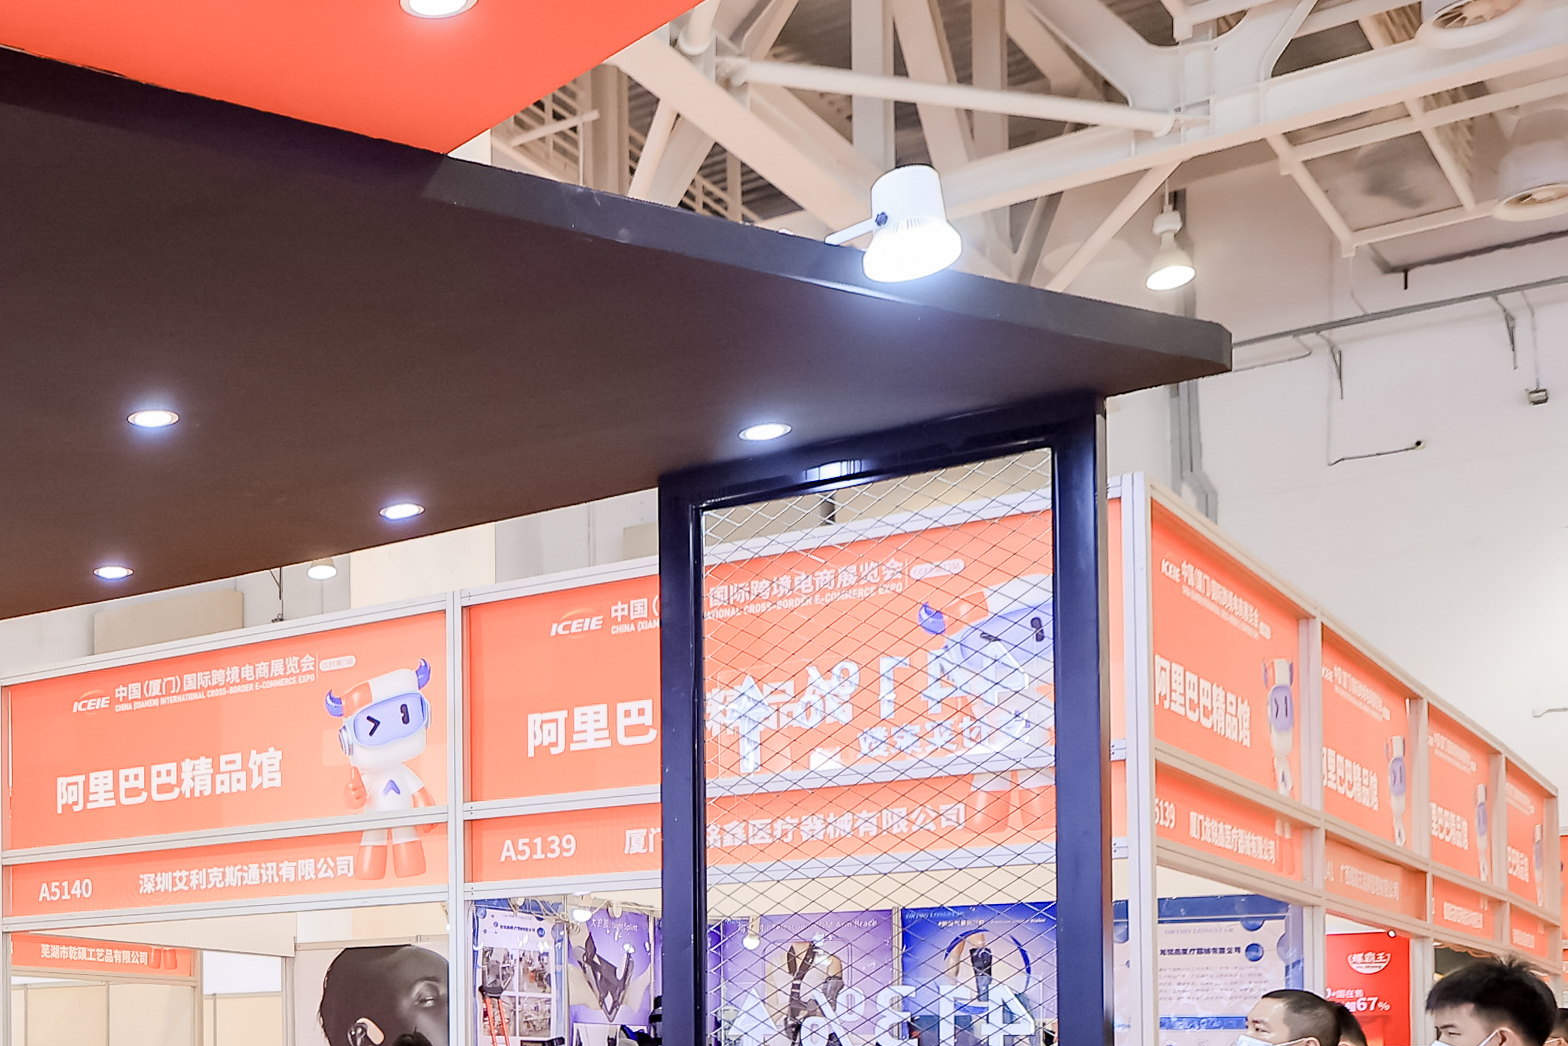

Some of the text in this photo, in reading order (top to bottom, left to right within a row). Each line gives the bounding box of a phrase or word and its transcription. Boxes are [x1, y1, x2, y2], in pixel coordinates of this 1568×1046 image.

[550, 615, 604, 637] ICEIE
[611, 623, 636, 635] CHINA
[815, 587, 876, 605] E-COMMERCE
[879, 581, 903, 595] EXPO
[72, 653, 316, 713] ICEIE 中国（厦门）国际跨境电商展览会
[115, 702, 133, 712] CHINA
[160, 691, 207, 708] INTERNATIONAL
[207, 683, 254, 699] CROSS-BORDER
[254, 676, 297, 693] E-COMMERCE
[298, 672, 315, 684] EXPO
[1154, 653, 1251, 748] 阿里巴巴精品馆
[527, 699, 659, 758] 阿里巴
[56, 747, 284, 815] 阿里巴巴精品馆
[500, 833, 577, 863] A5139
[38, 854, 356, 902] A5140 深圳艾利克斯通讯有限公司
[40, 943, 149, 966] 芜湖市乾硕工艺品有限公司
